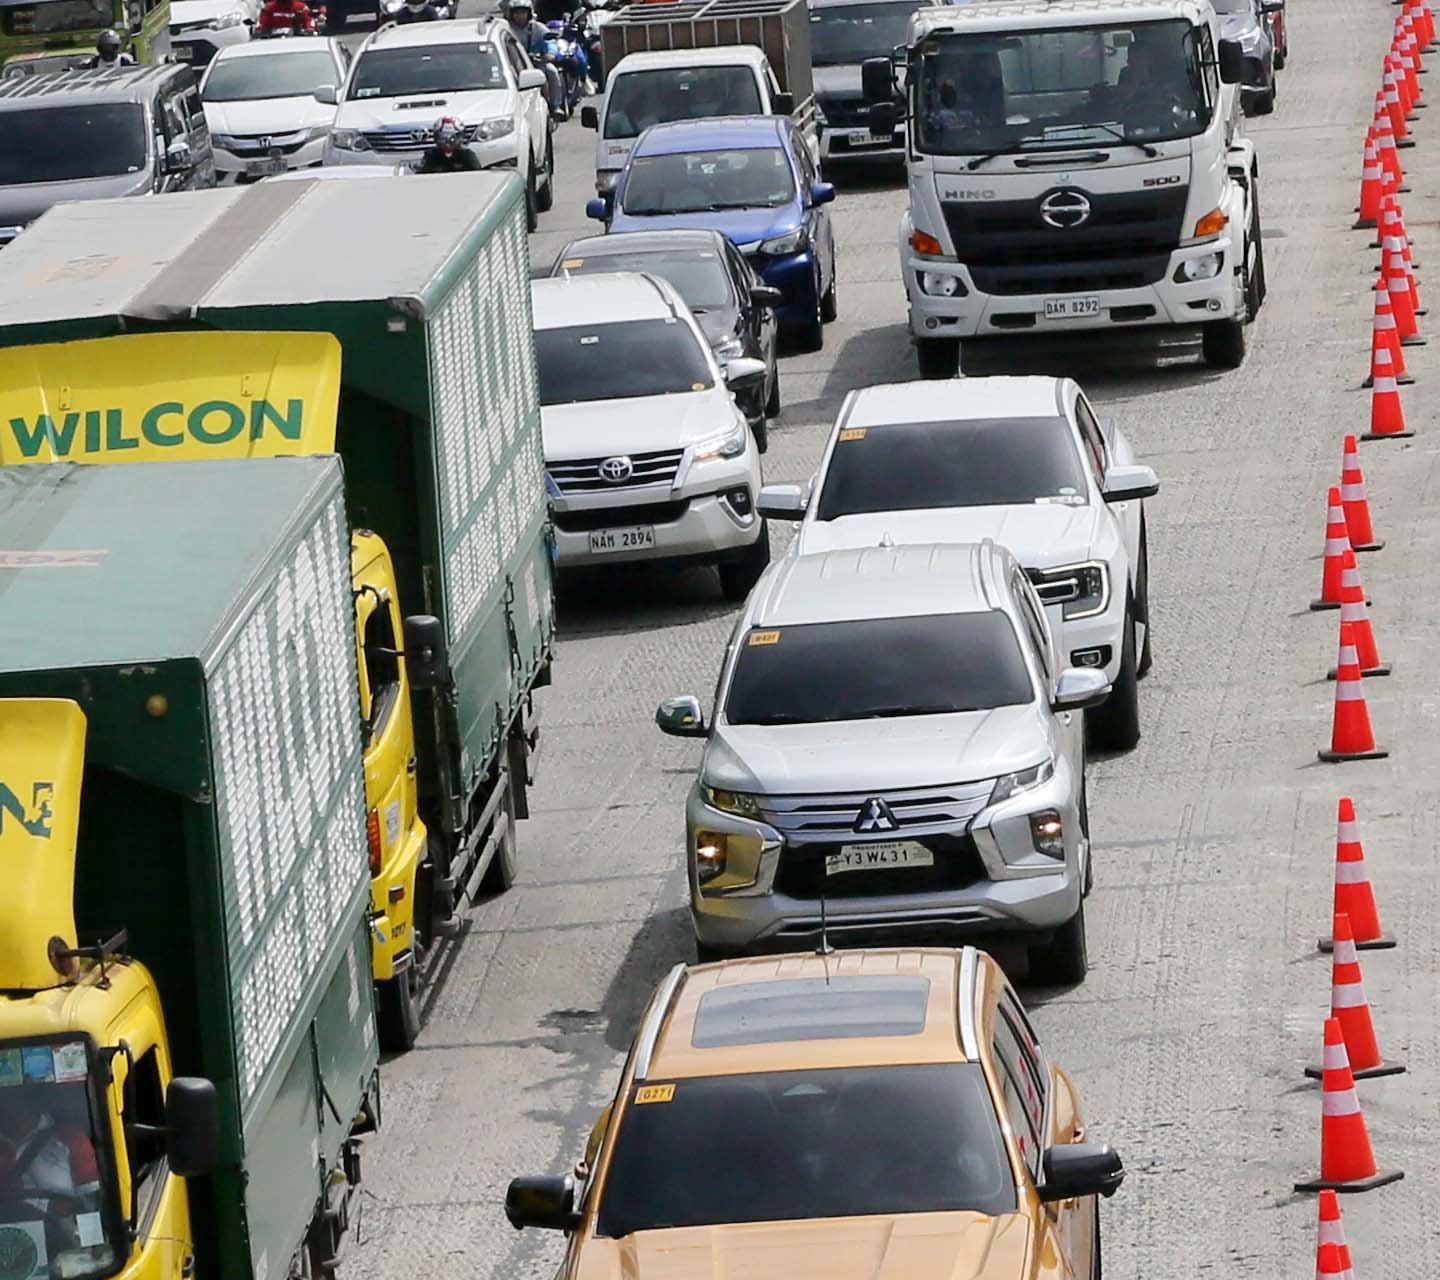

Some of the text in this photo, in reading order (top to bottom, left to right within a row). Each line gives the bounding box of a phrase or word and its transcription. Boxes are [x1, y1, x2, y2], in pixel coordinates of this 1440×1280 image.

[1143, 177, 1181, 187] 500
[945, 187, 996, 200] HINO
[1047, 301, 1098, 314] DAM 8292
[9, 399, 303, 458] WILCON
[591, 531, 653, 549] NAM 2894
